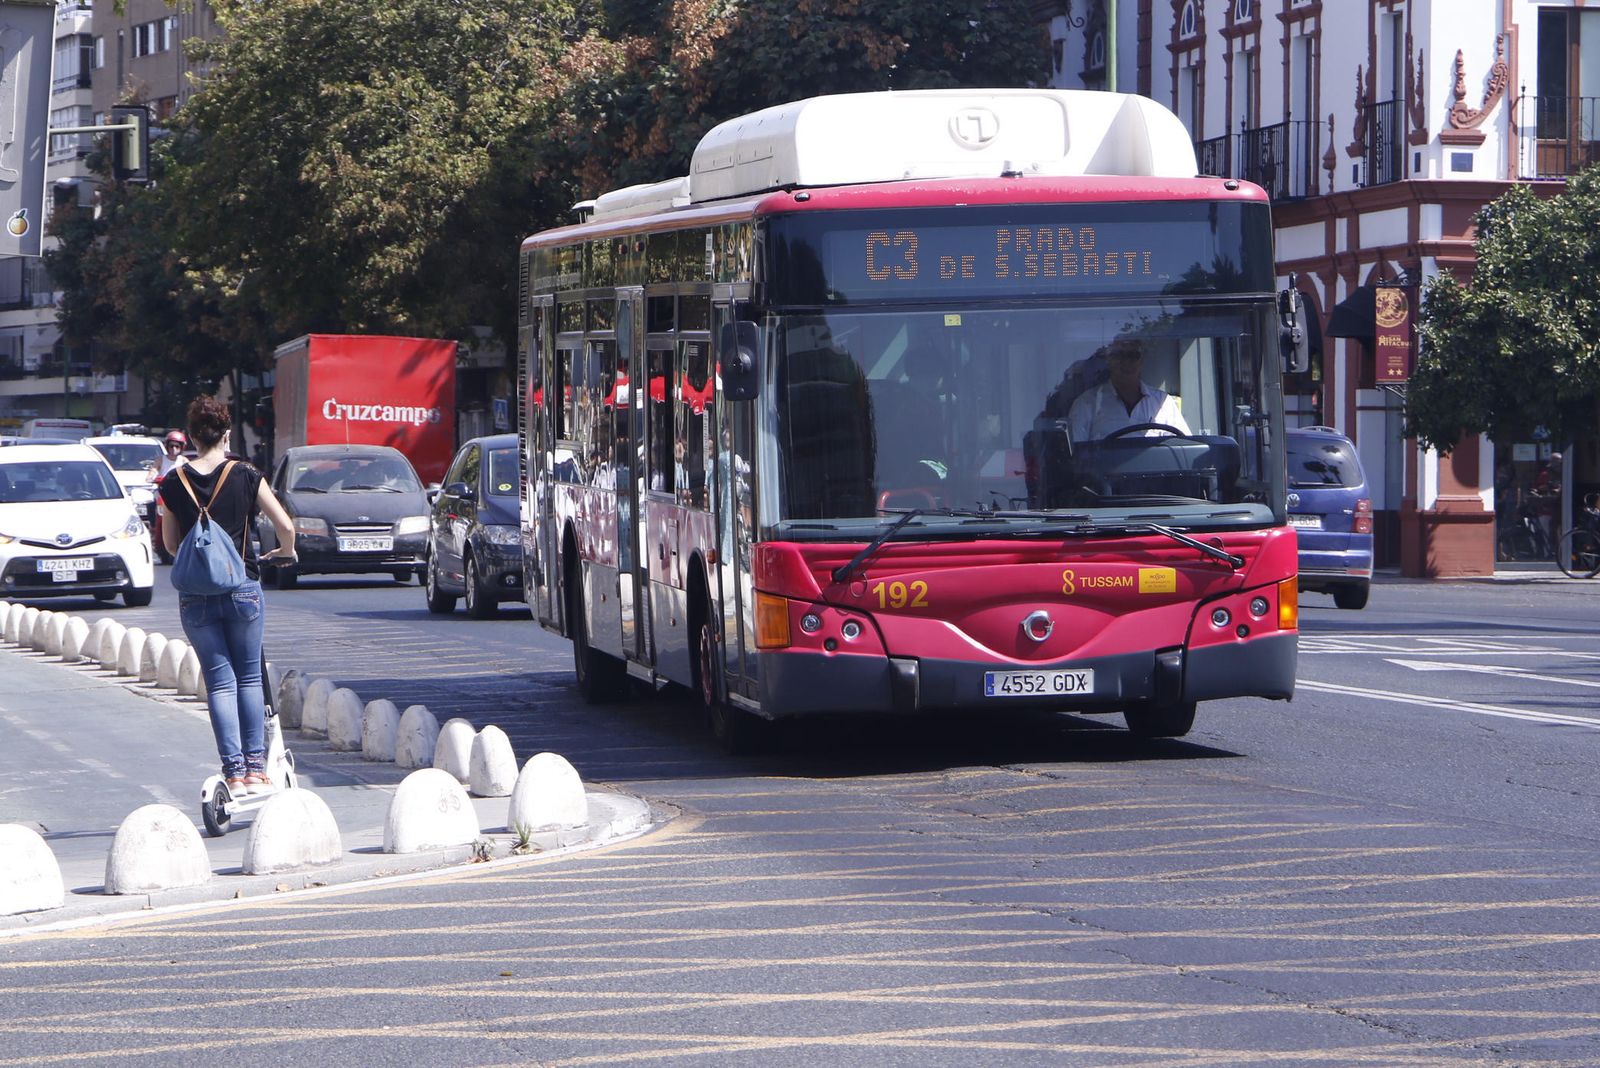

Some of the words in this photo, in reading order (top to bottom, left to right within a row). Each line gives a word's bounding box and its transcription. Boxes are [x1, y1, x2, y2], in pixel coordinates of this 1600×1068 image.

[995, 226, 1096, 252] PRADO
[865, 231, 919, 281] C3
[939, 255, 976, 280] DE
[995, 250, 1153, 279] S.SEBASTI
[322, 398, 441, 426] Cruzcampo
[44, 561, 68, 570] 4241
[72, 559, 91, 569] KHZ
[55, 571, 74, 581] SP
[872, 580, 929, 609] 192
[1080, 576, 1134, 588] TUSSAM
[1001, 675, 1046, 693] 4552
[1053, 673, 1086, 692] GDX
